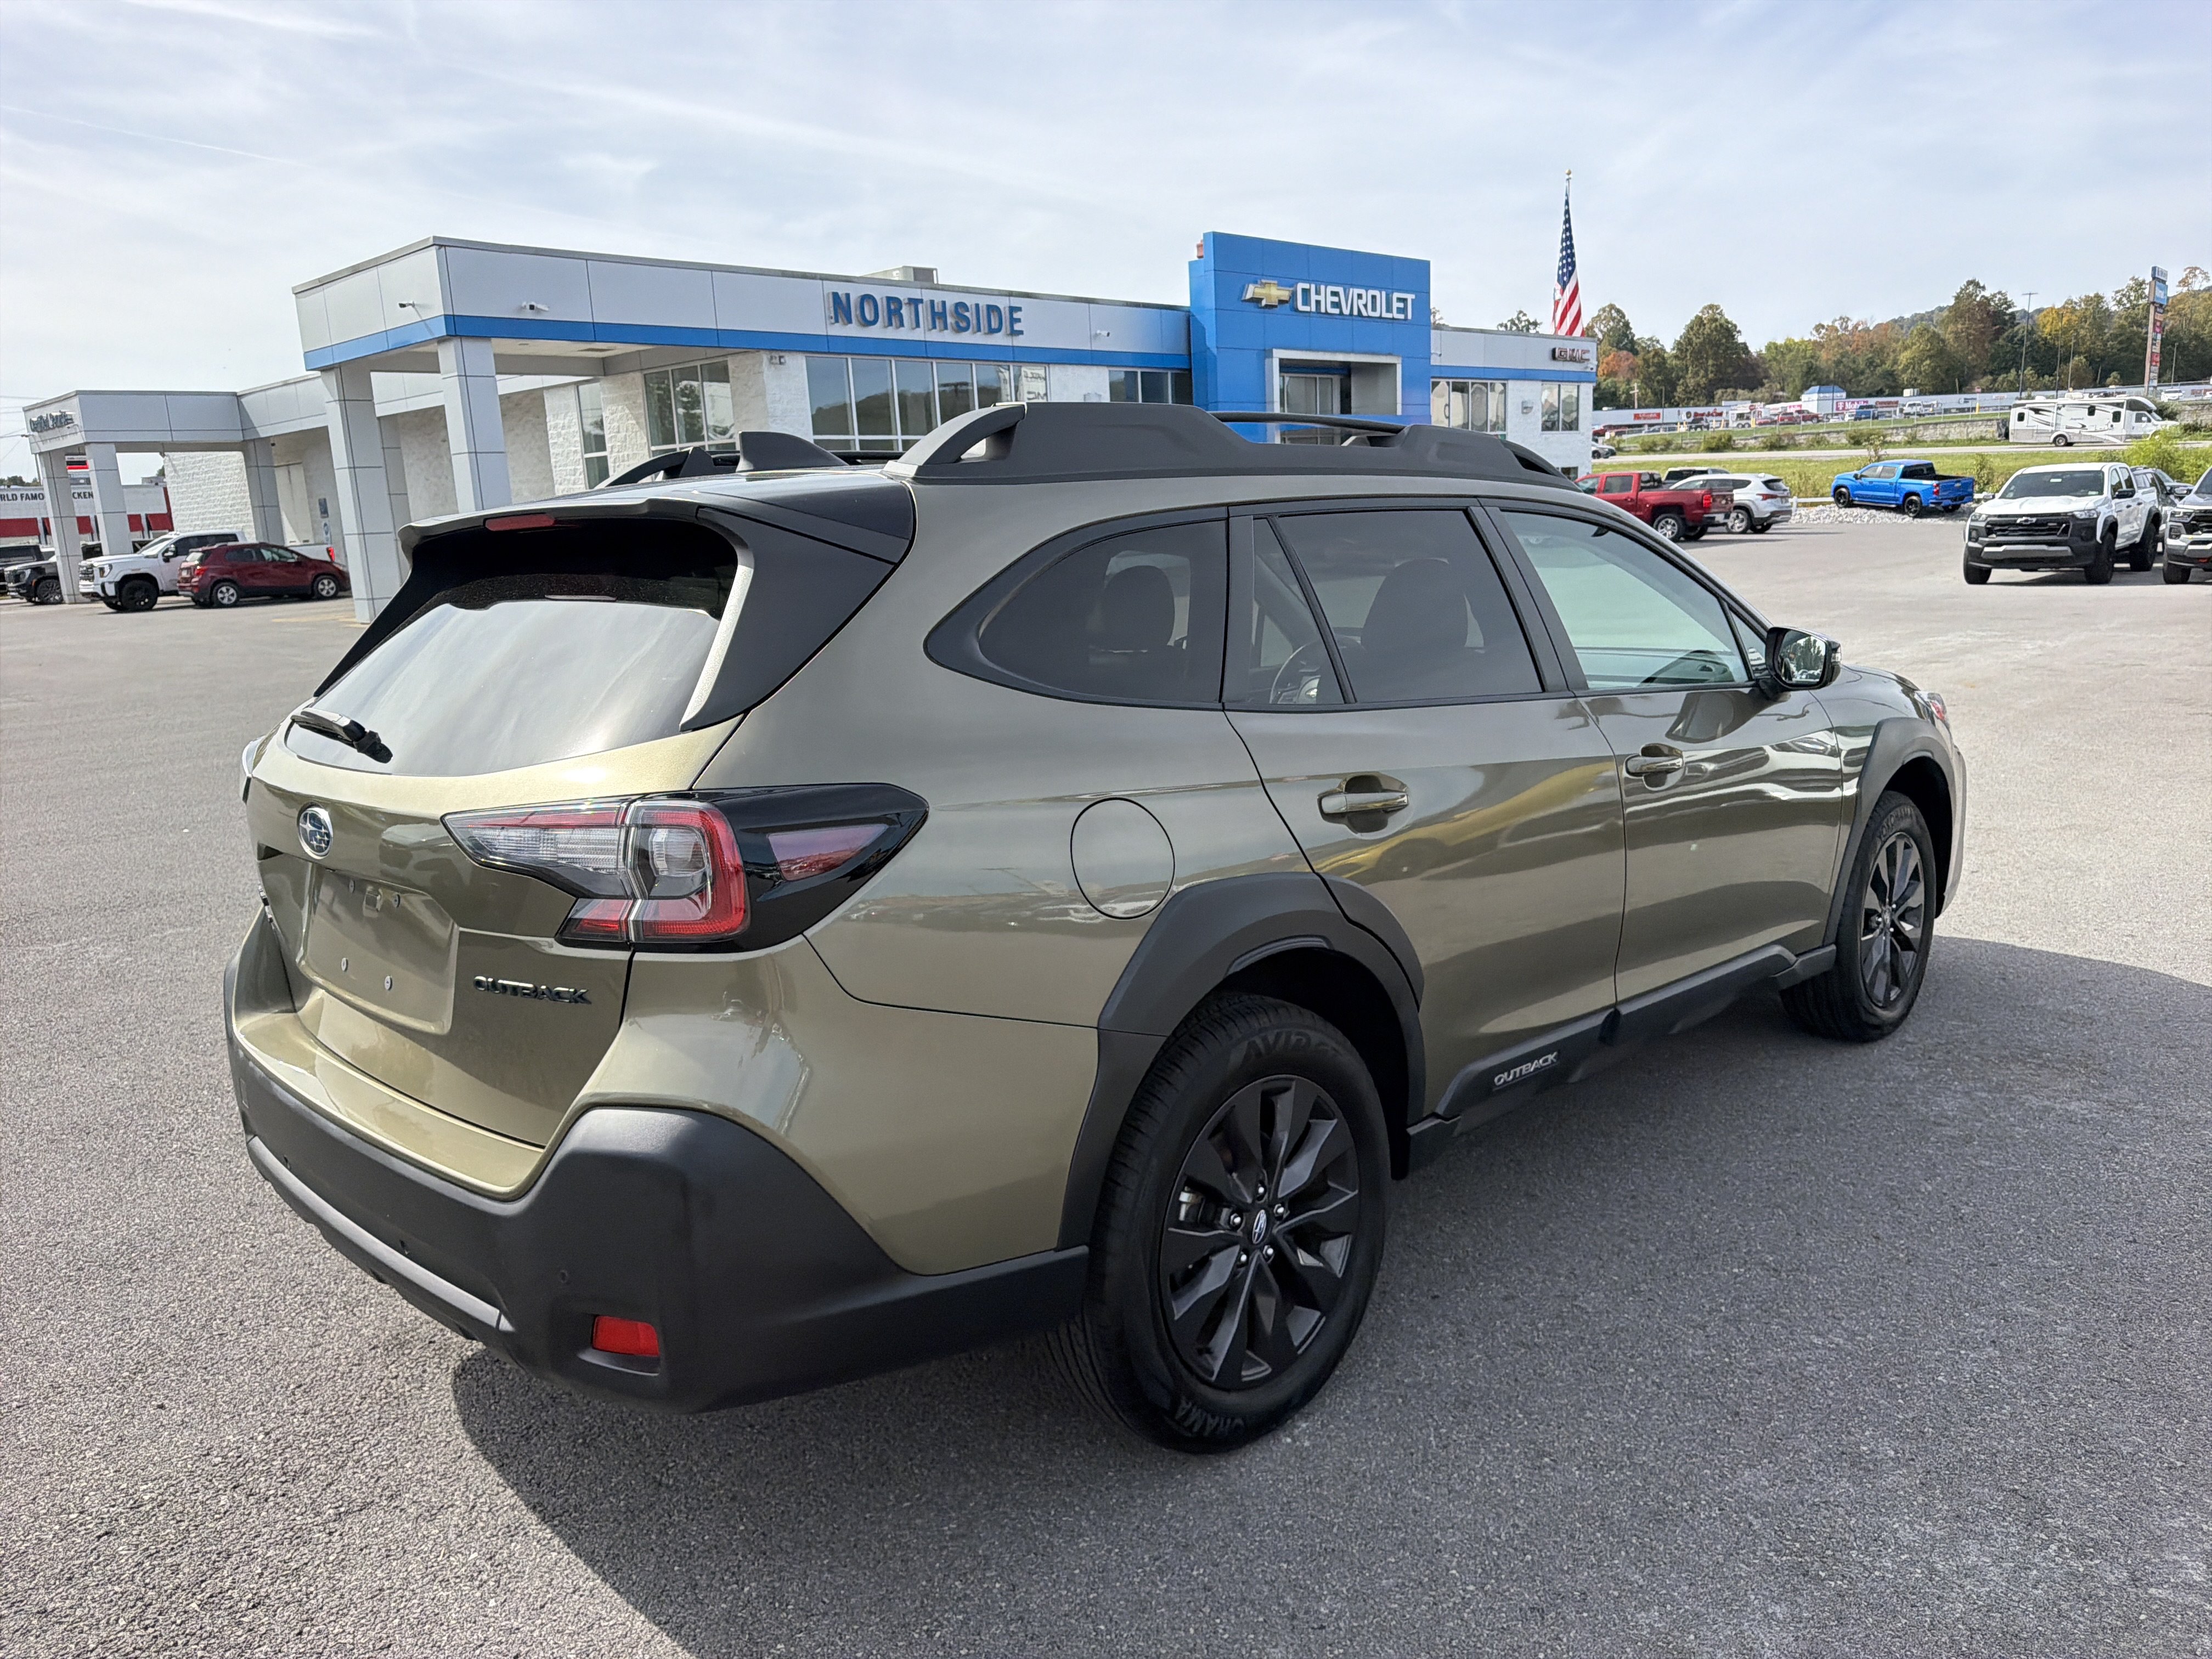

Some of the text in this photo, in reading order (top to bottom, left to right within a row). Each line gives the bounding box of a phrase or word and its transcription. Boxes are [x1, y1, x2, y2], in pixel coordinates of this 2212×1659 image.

[828, 291, 1024, 336] NORTHSIDE
[1296, 282, 1415, 320] CHEVROLET
[1552, 347, 1590, 363] GMC
[1845, 401, 1867, 410] Mob
[0, 491, 94, 502] RLD FAMO CKEN
[473, 975, 592, 1005] OUTBACK
[1494, 1052, 1558, 1086] OUTBACK
